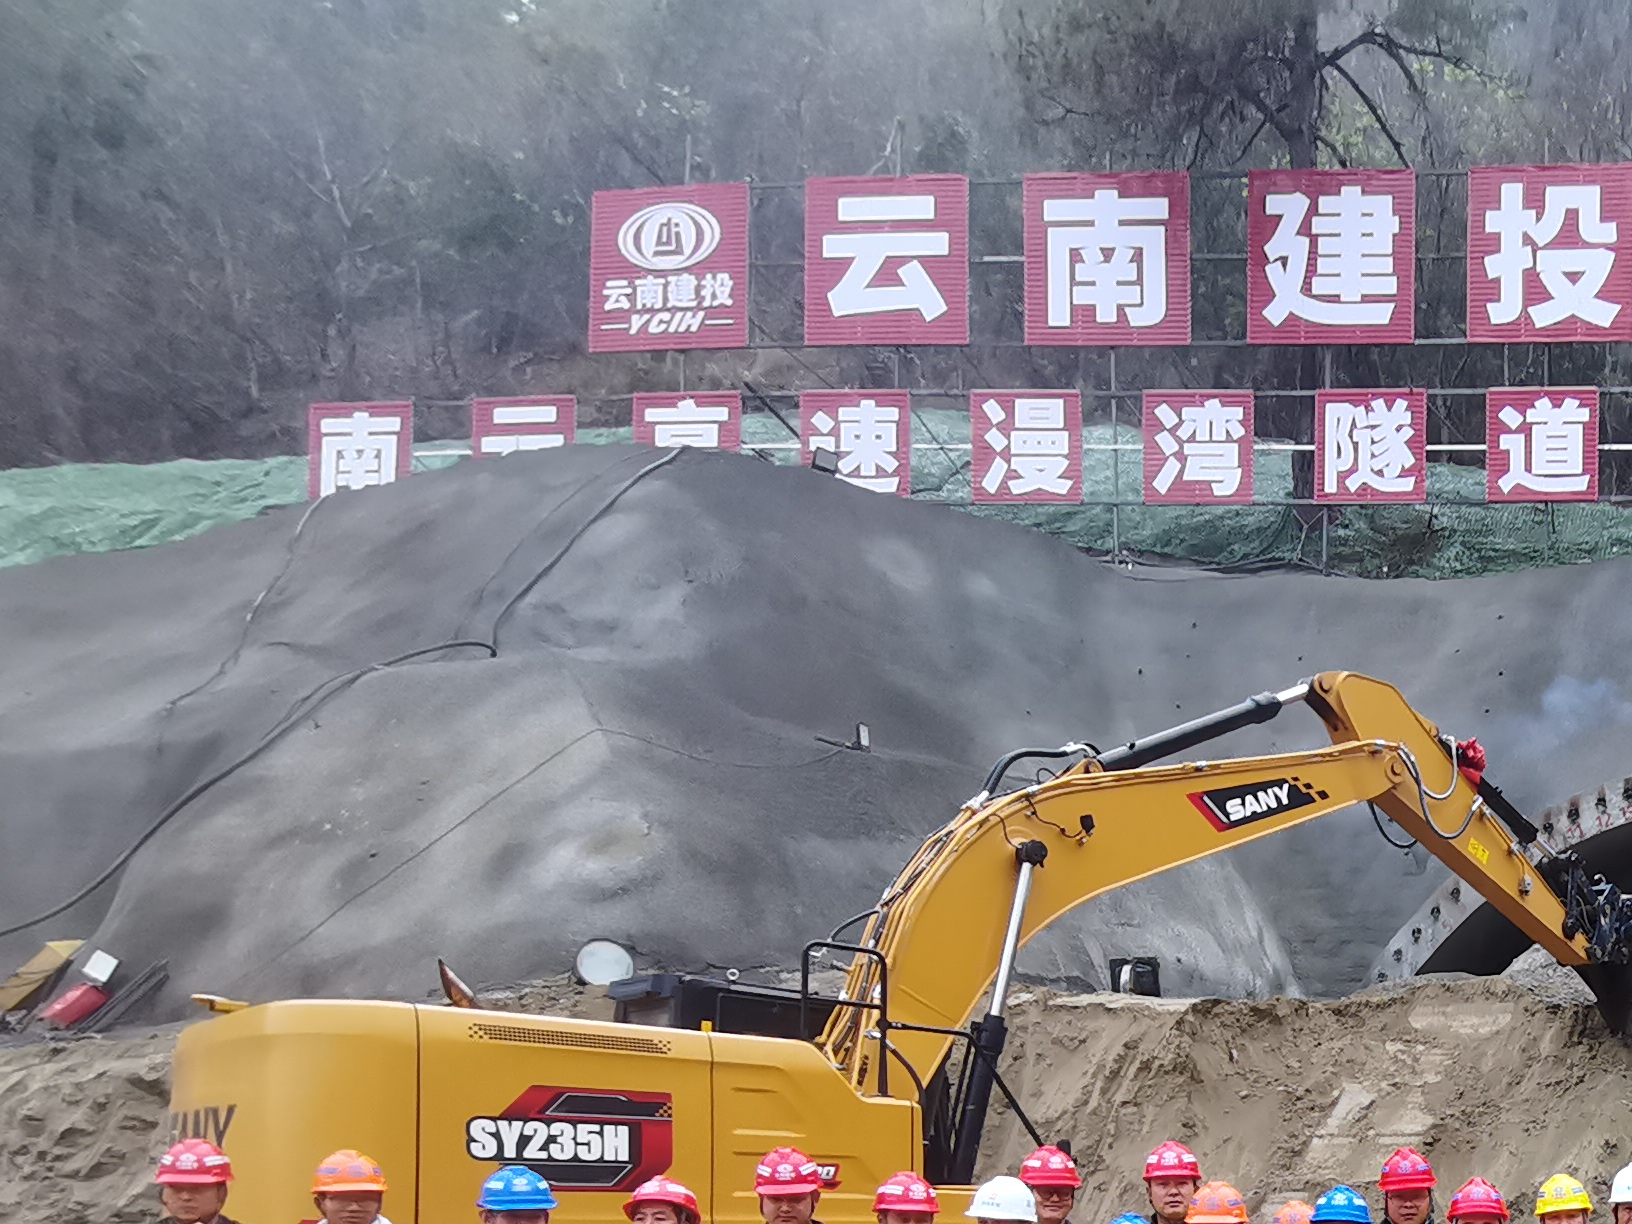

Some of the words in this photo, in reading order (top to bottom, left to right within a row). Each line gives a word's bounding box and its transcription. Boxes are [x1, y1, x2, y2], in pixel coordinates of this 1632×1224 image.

[821, 182, 1622, 328] 云南建投
[602, 272, 734, 311] 云南建投
[628, 310, 706, 335] YCIH
[1225, 782, 1290, 822] SANY
[469, 1117, 631, 1164] SY235H
